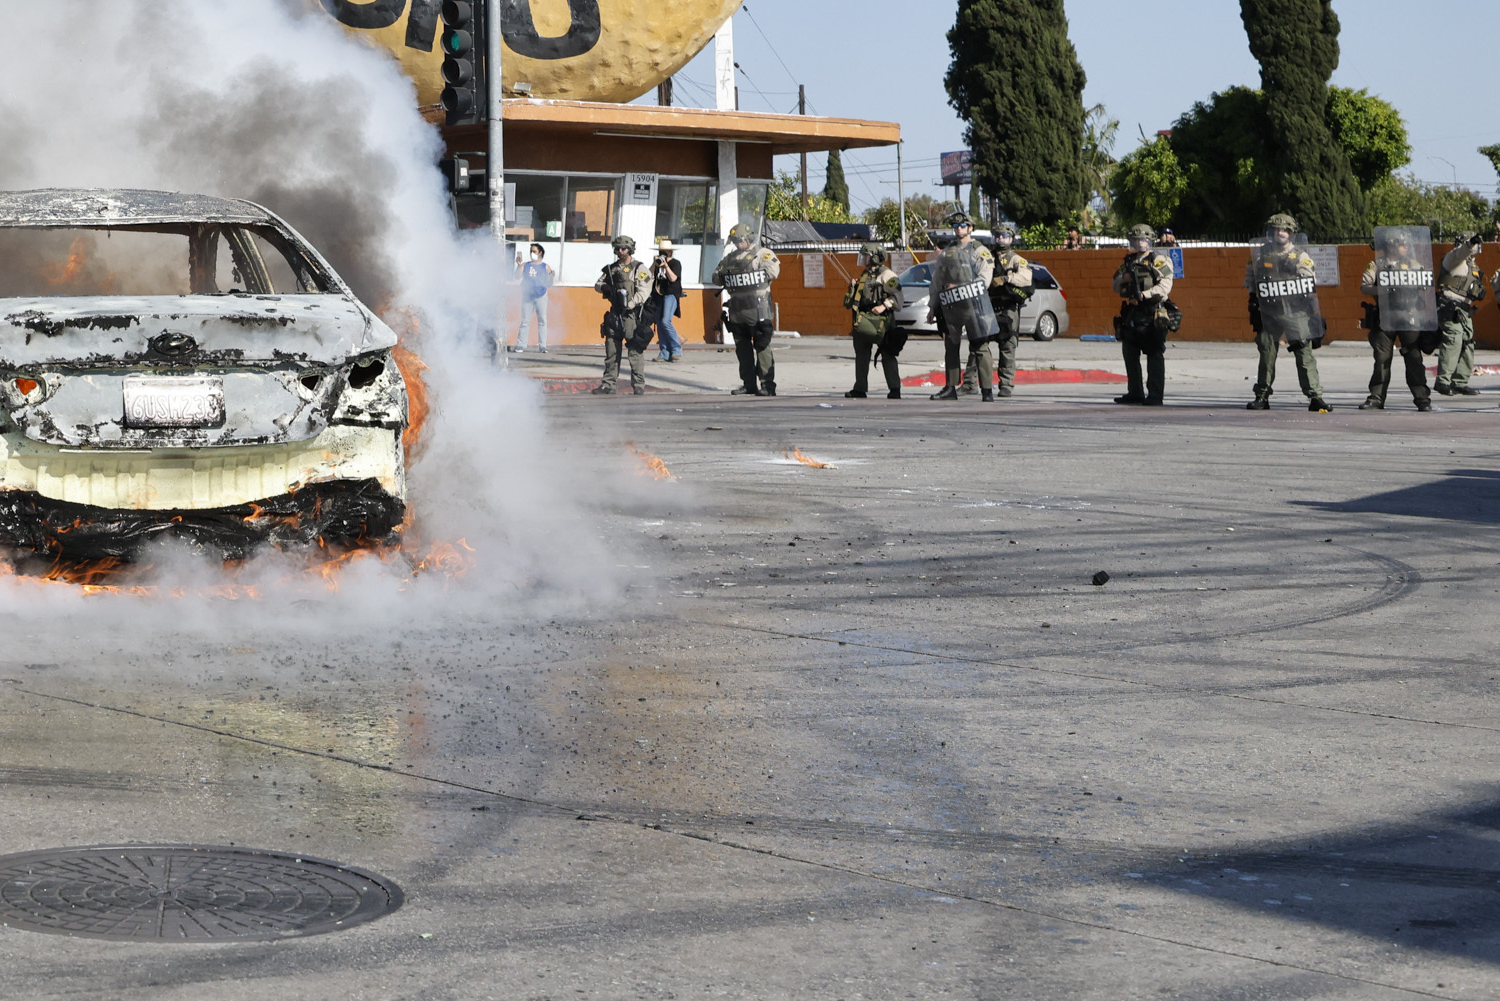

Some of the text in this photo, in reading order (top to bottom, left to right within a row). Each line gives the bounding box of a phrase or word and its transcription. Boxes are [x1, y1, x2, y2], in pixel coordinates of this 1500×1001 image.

[632, 174, 655, 183] 15904
[725, 270, 766, 287] SHERIFF
[1379, 271, 1433, 287] SHERIFF
[939, 281, 985, 305] SHERIFF
[1258, 278, 1315, 298] SHERIFF
